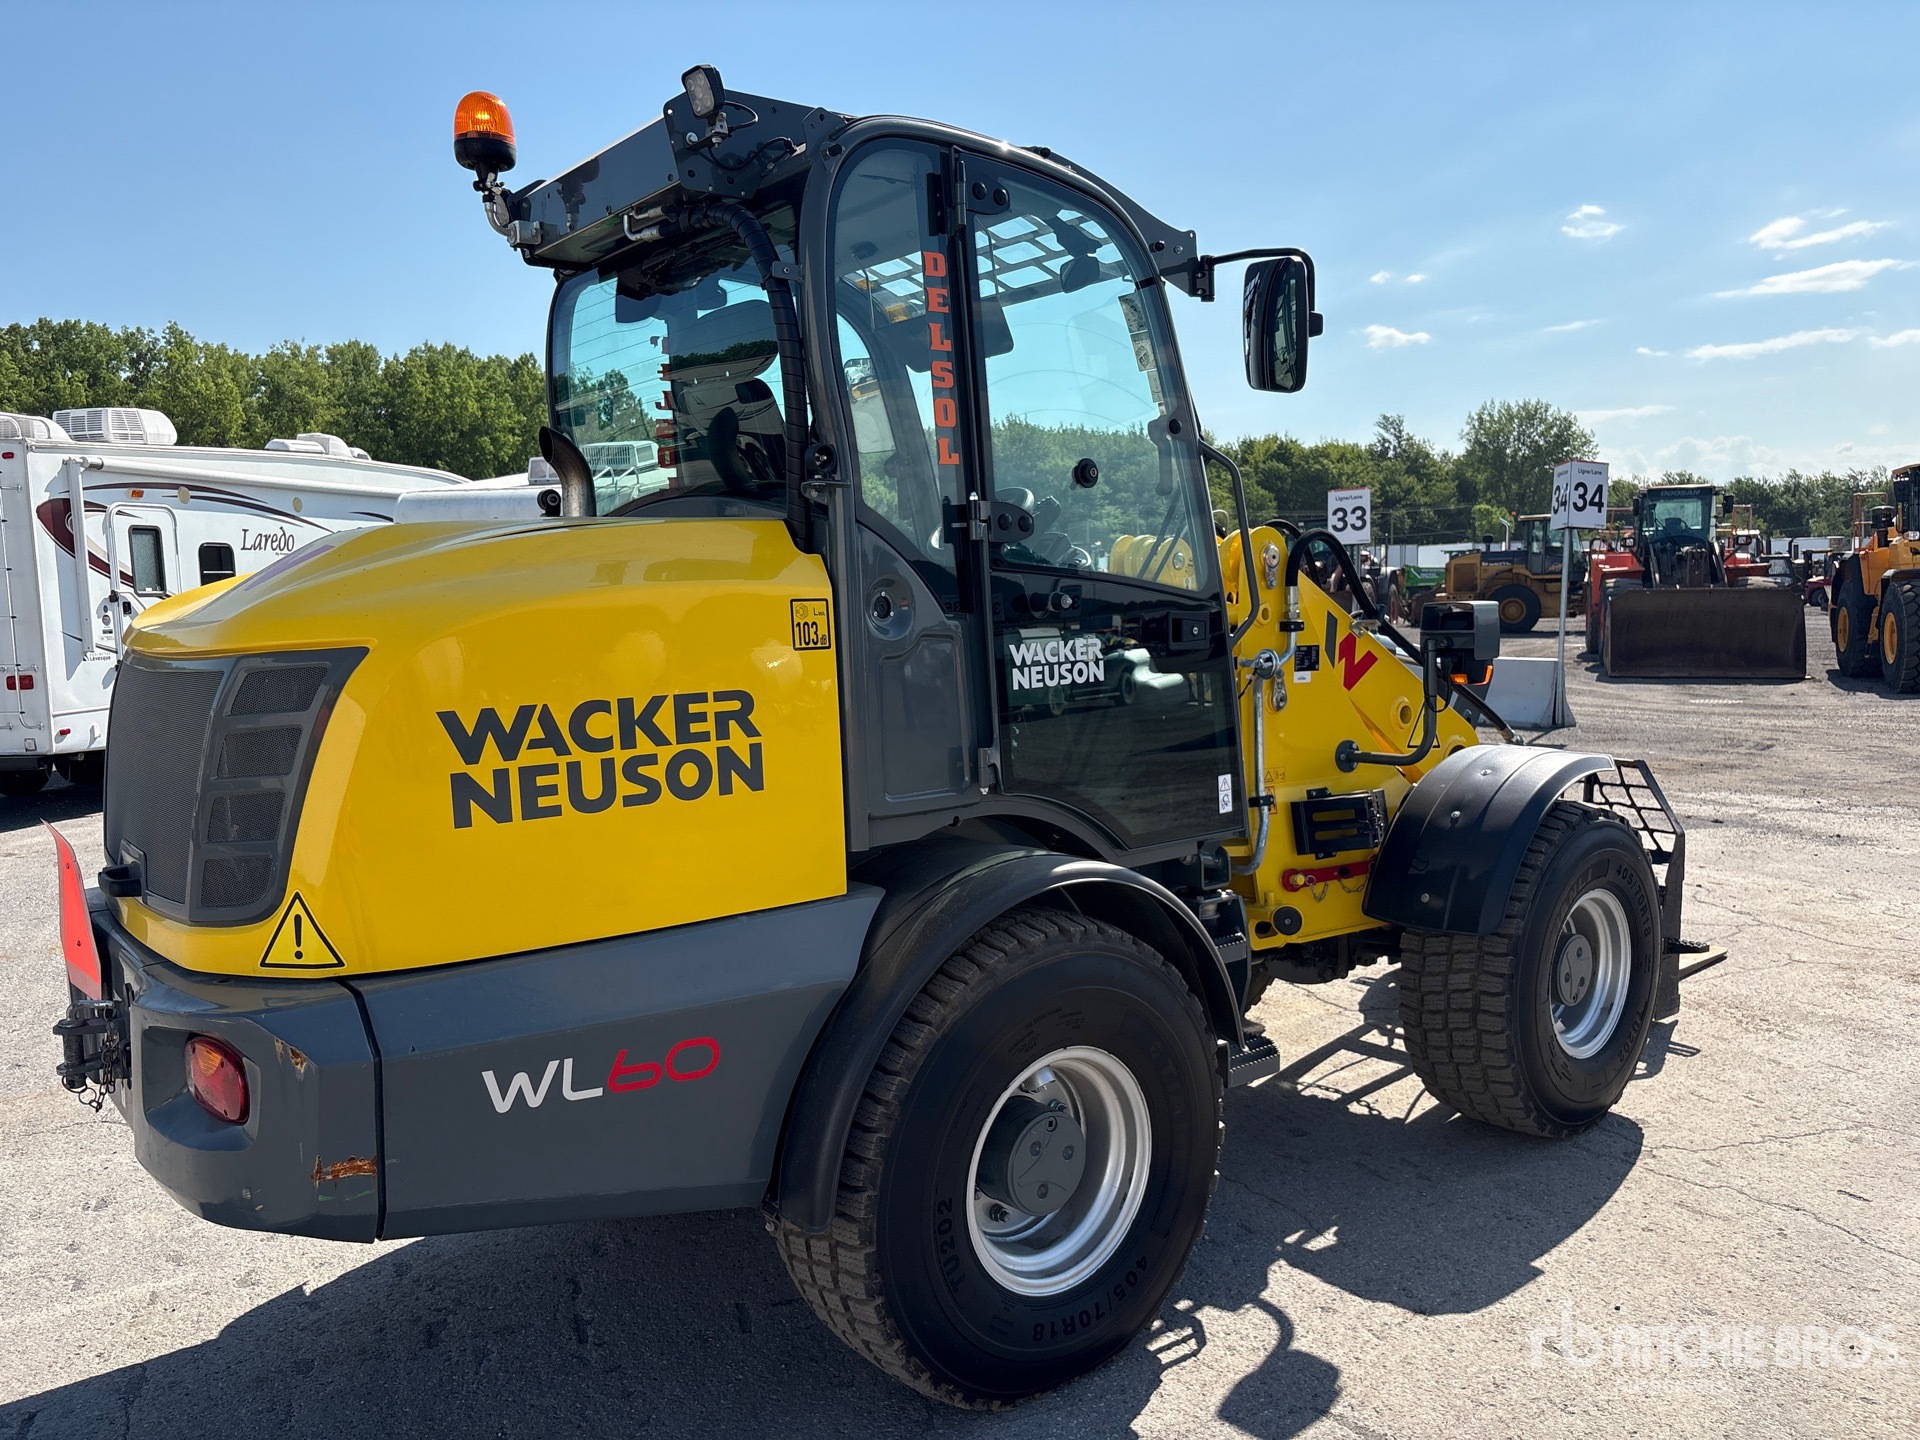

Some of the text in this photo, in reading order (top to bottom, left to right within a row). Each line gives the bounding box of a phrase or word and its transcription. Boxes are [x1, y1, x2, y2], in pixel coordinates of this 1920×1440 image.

[922, 251, 960, 465] DELSOL
[1553, 482, 1568, 515] 34
[1572, 482, 1604, 513] 34
[1331, 506, 1367, 532] 33
[241, 526, 295, 552] Laredo
[796, 621, 819, 646] 103
[1009, 638, 1104, 666] WACKER
[1012, 660, 1105, 690] NEUSON
[436, 690, 763, 765] WACKER
[450, 742, 764, 829] NEUSON
[481, 1036, 721, 1114] WL60
[937, 1197, 966, 1293] TU202
[1032, 1255, 1147, 1342] 405/70R18
